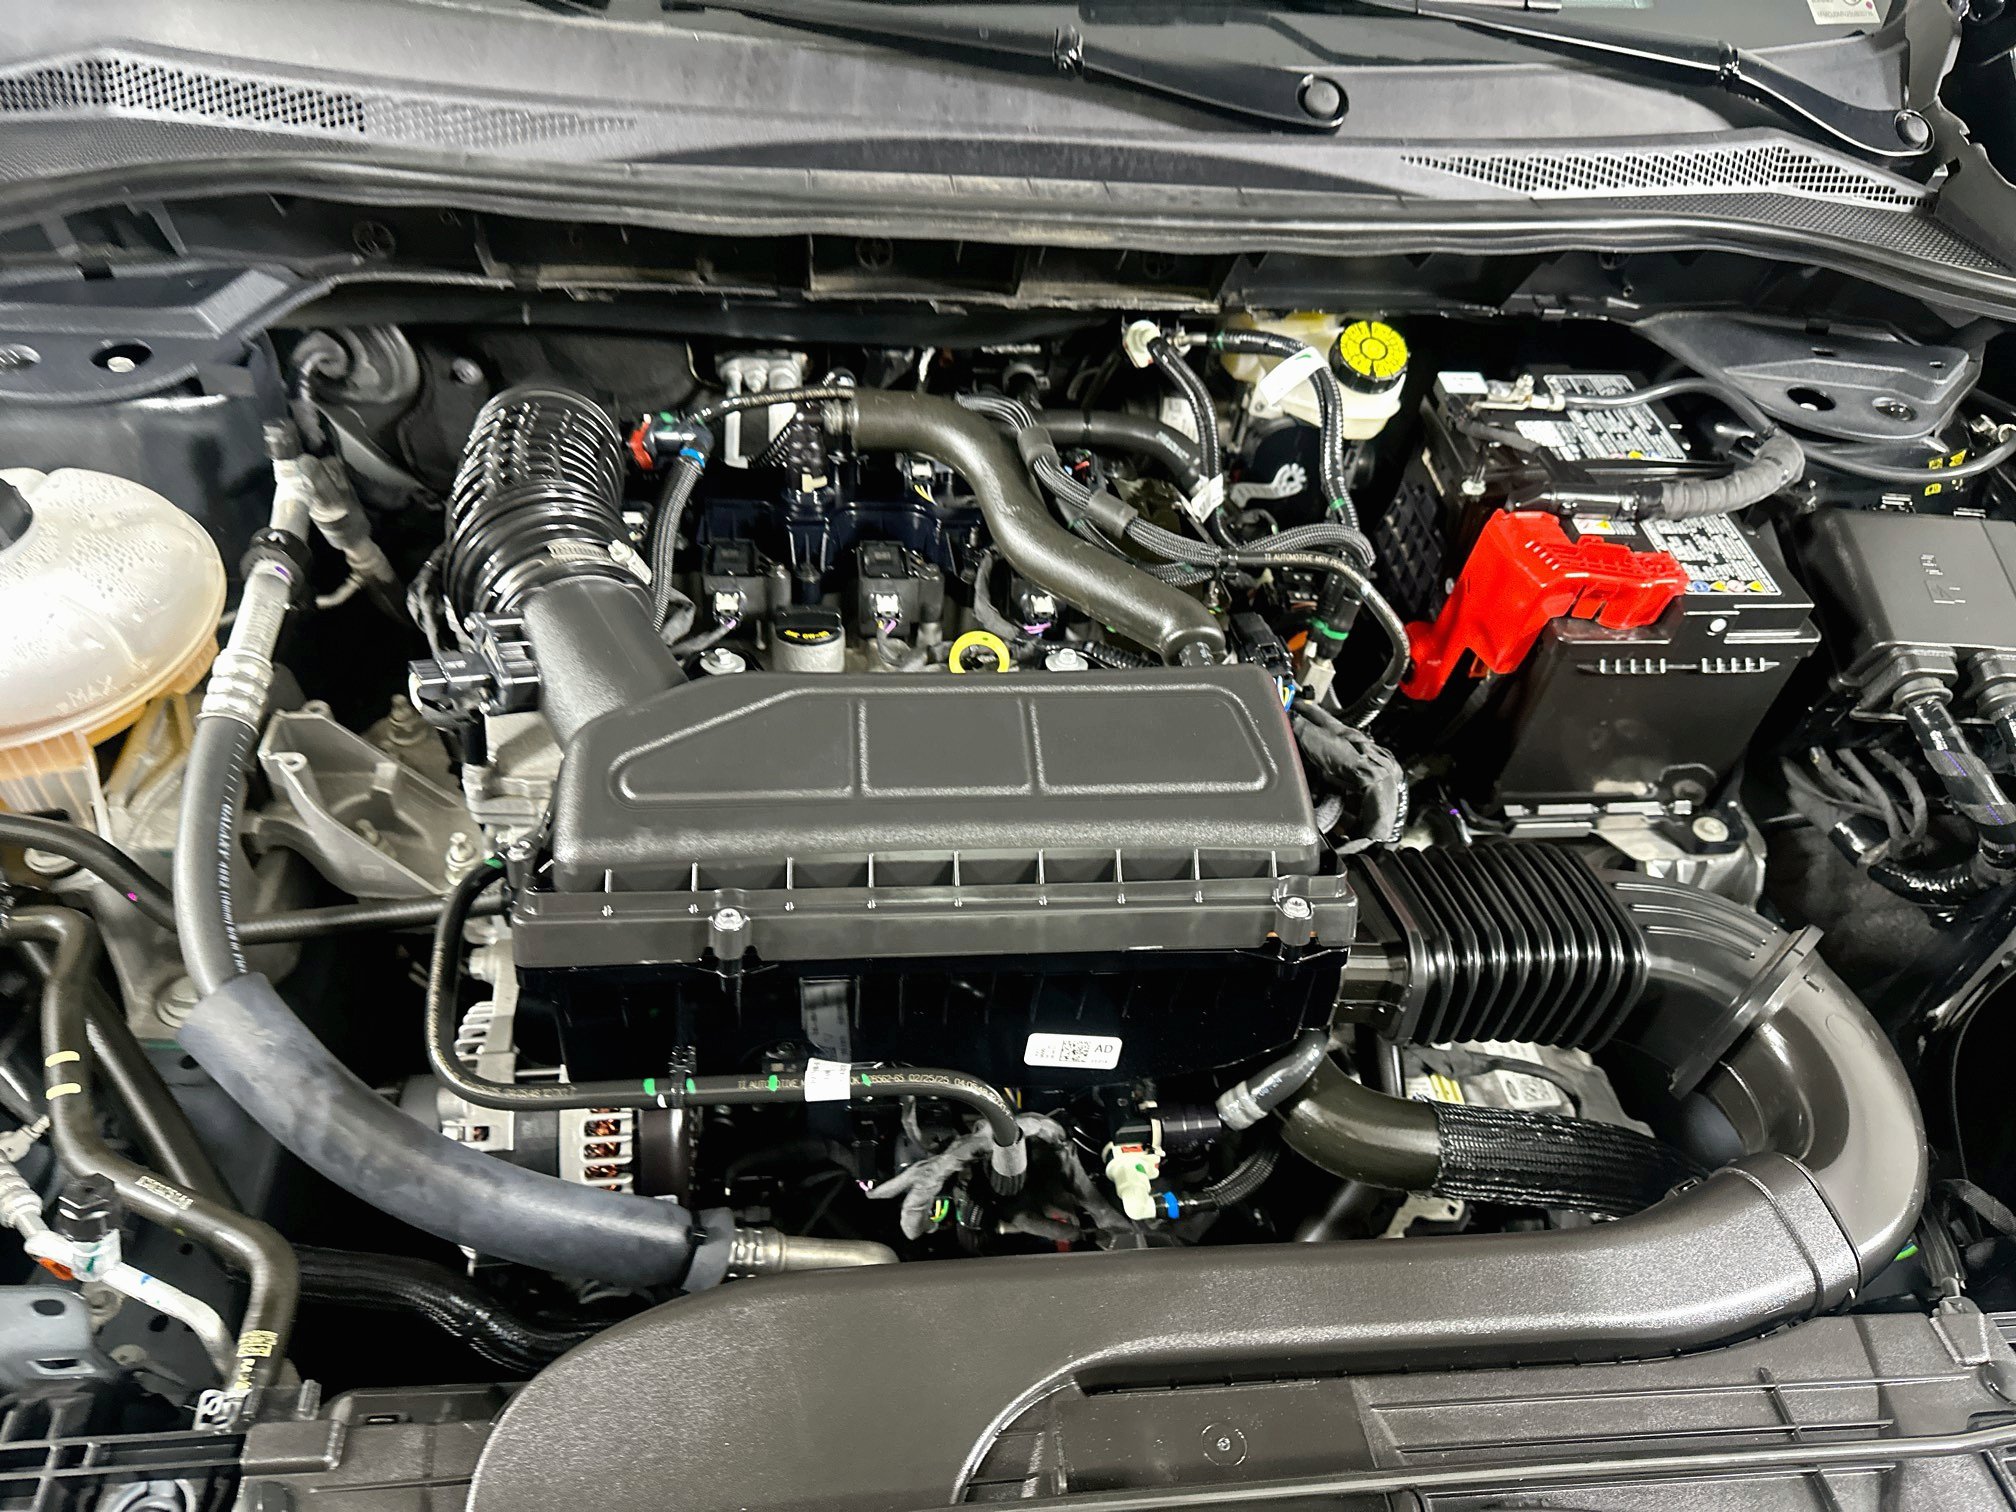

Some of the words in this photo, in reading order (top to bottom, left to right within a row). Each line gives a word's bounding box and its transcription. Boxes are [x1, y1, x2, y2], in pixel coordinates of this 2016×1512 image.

[1273, 553, 1314, 563] AUTOMOTIVE
[65, 674, 119, 708] MAX
[1094, 1044, 1114, 1054] AD
